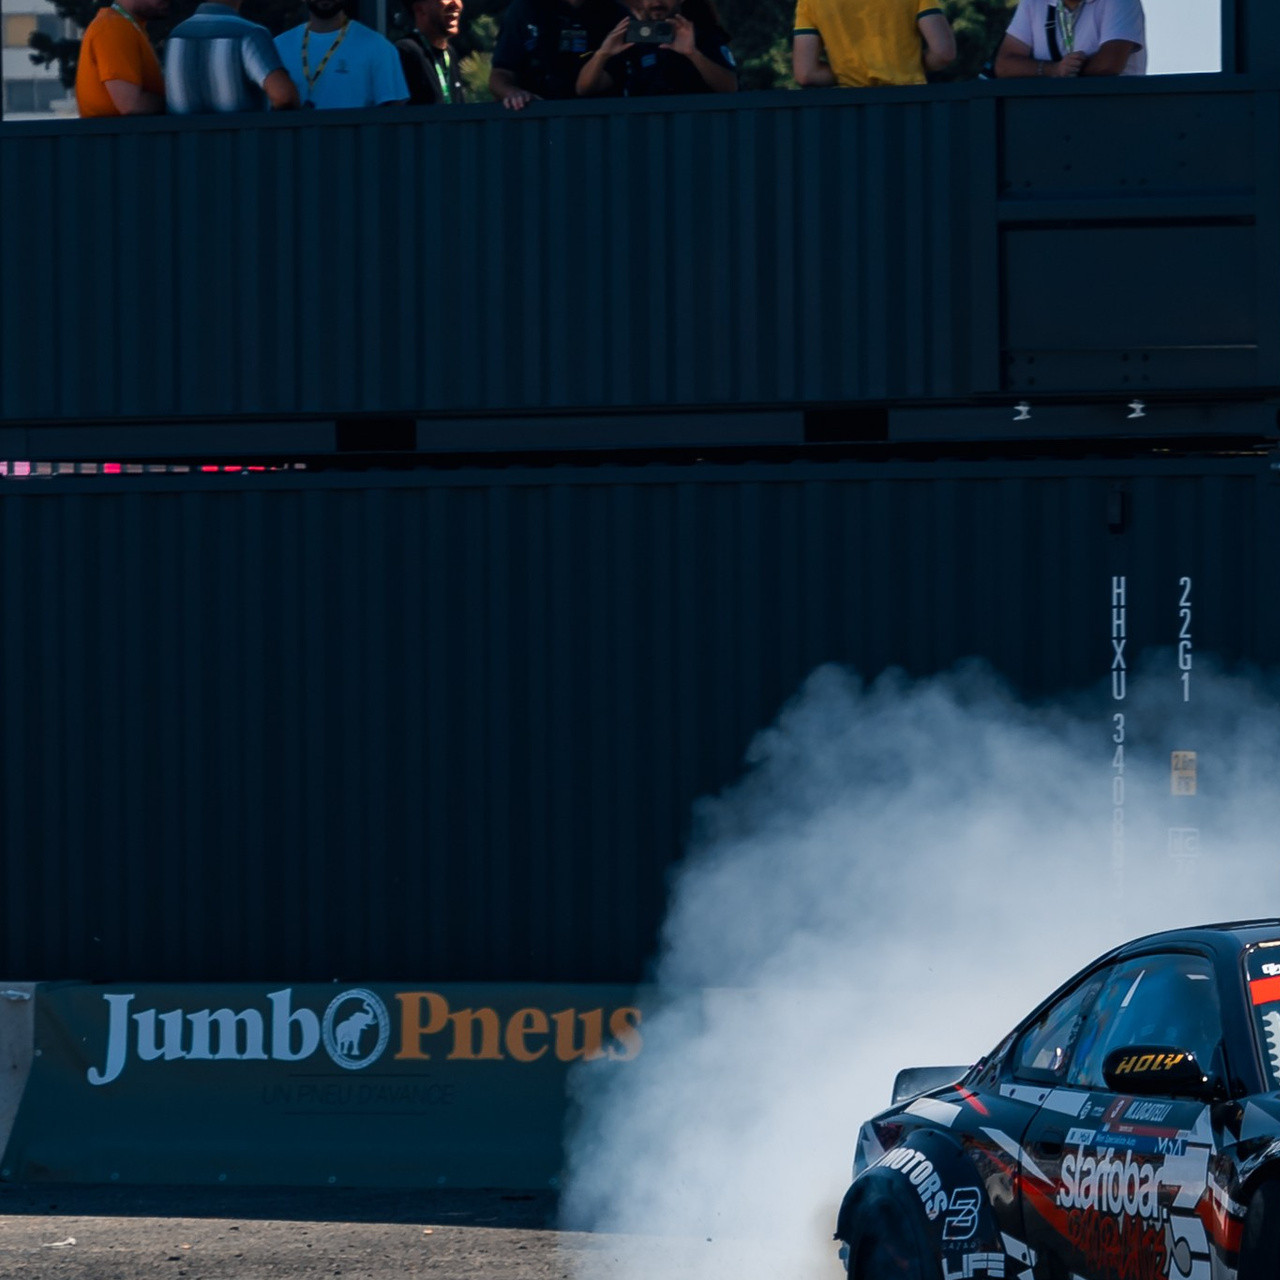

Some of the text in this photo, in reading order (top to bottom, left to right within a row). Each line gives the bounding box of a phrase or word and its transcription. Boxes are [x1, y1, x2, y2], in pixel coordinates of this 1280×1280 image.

[1111, 575, 1126, 701] HHXU
[1178, 575, 1192, 702] 22G1
[394, 991, 643, 1062] Pneus
[1115, 1053, 1184, 1075] HOLY
[876, 1147, 948, 1221] MOTORS
